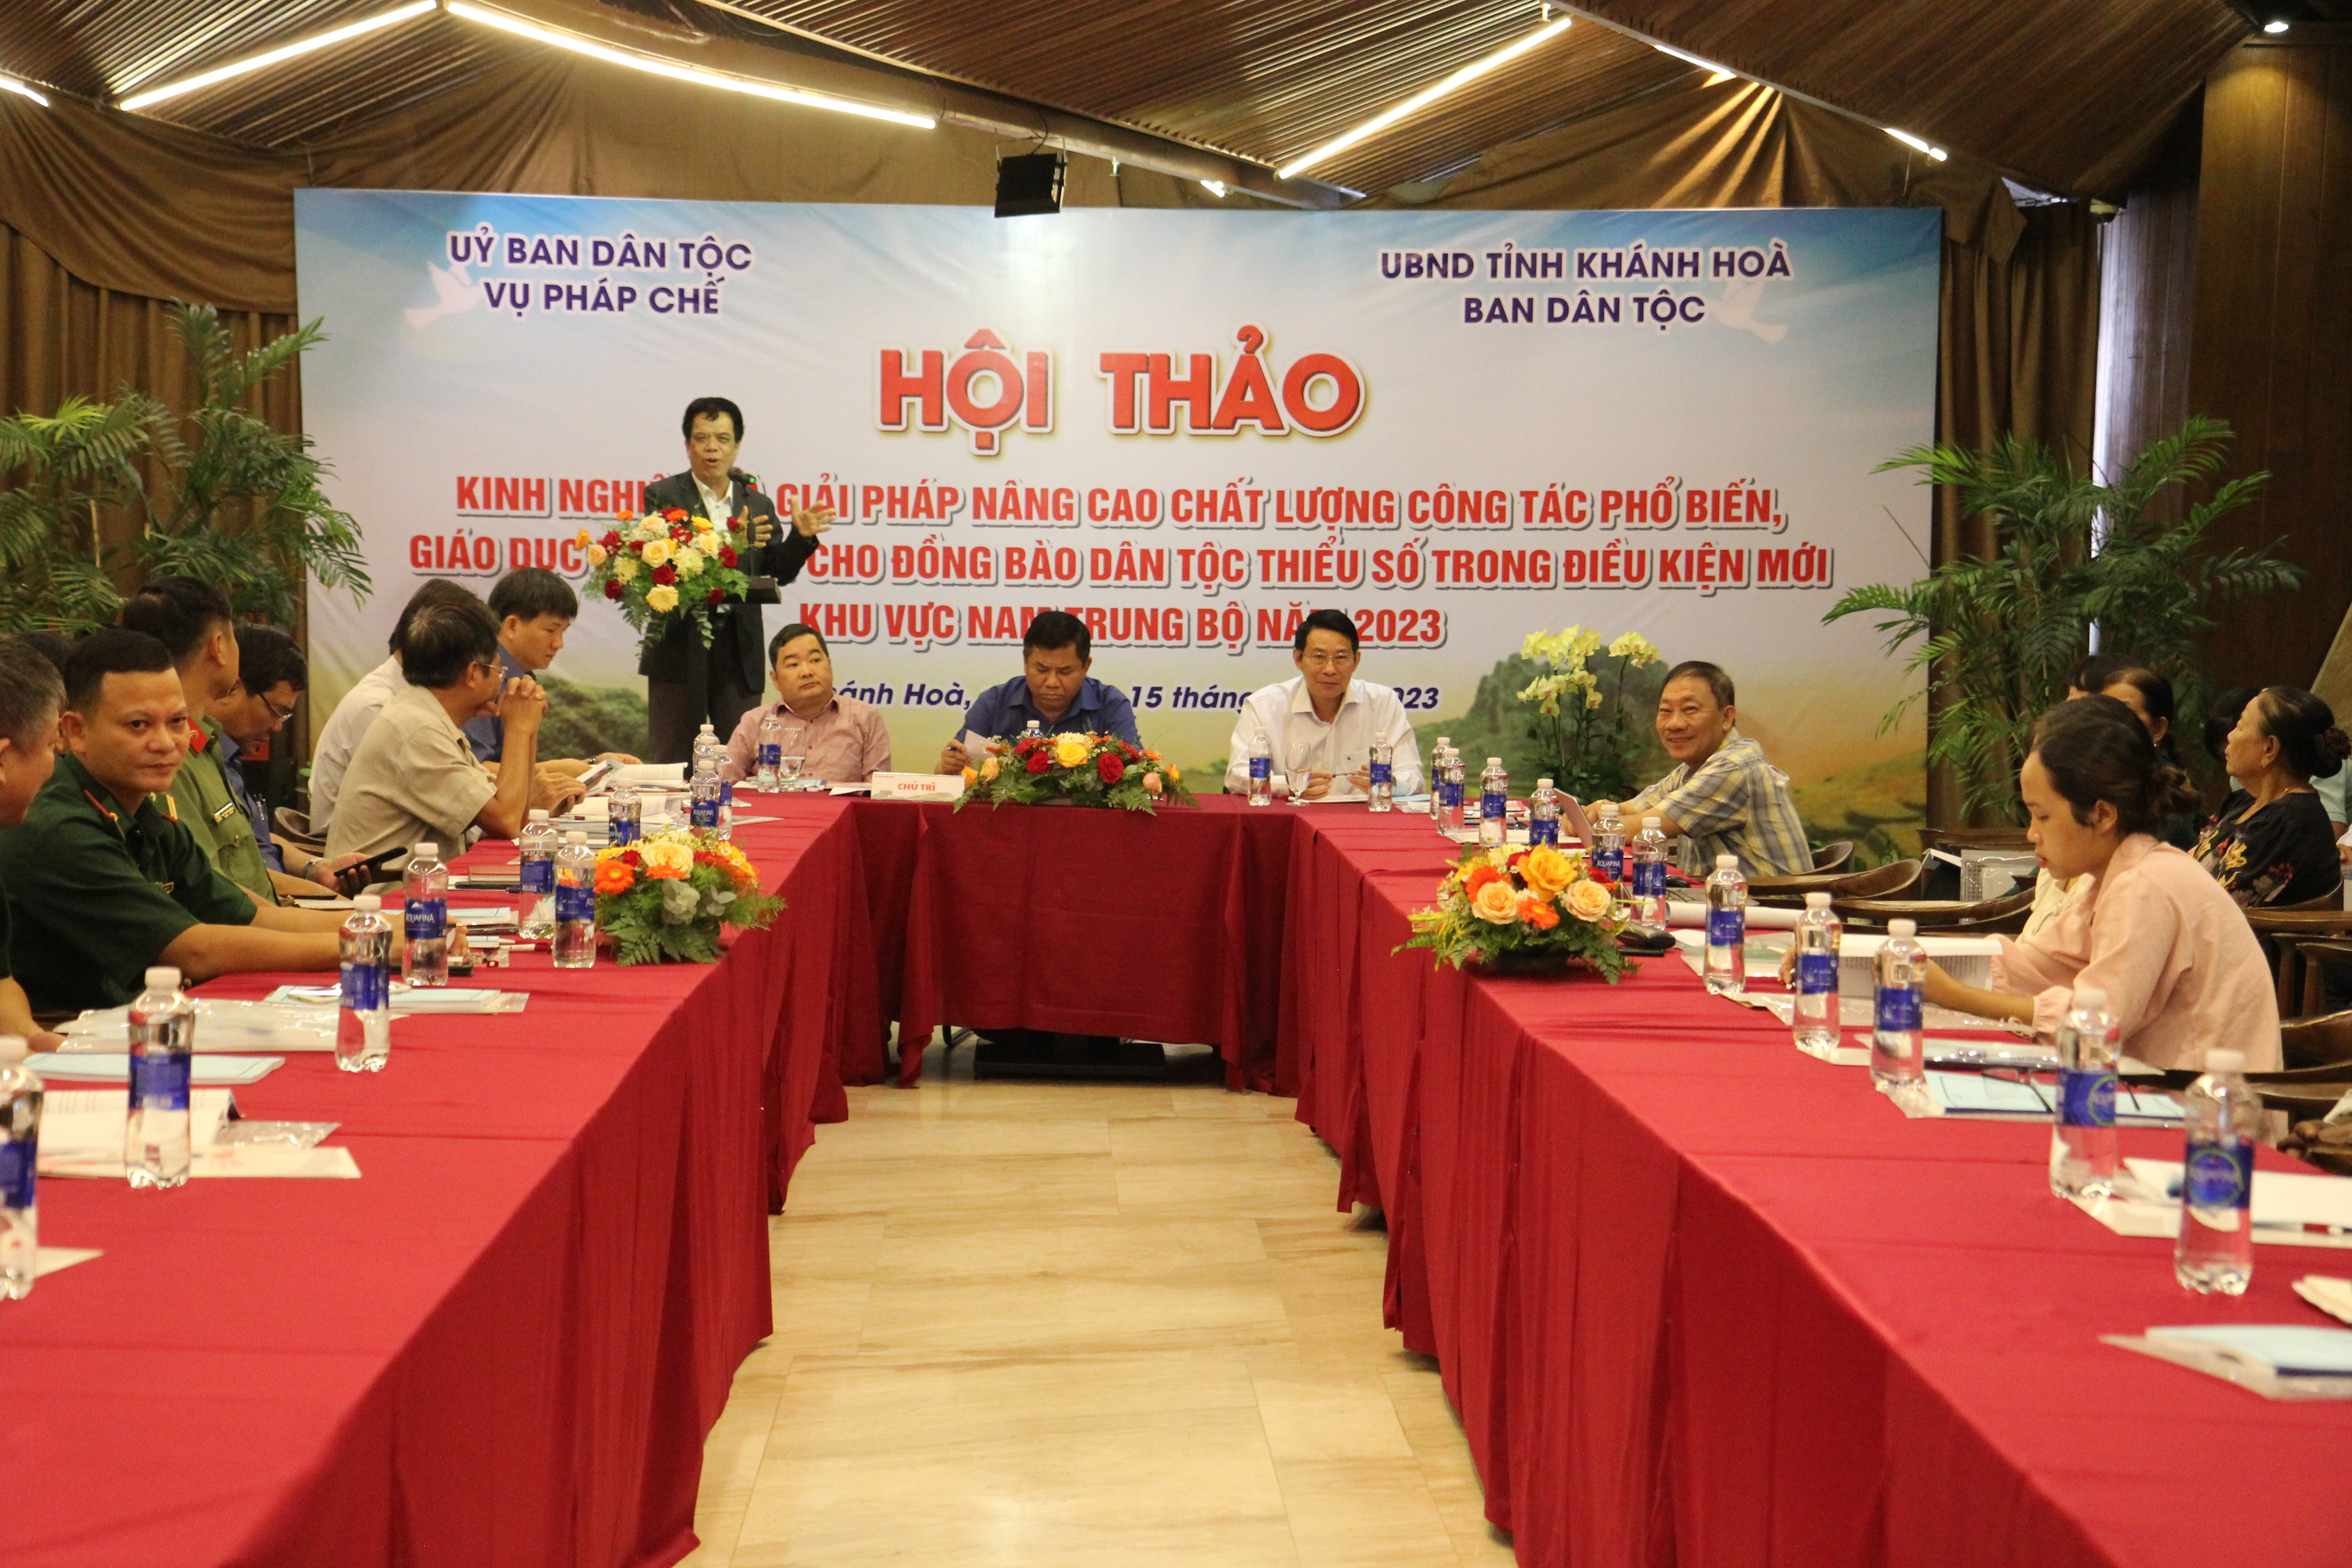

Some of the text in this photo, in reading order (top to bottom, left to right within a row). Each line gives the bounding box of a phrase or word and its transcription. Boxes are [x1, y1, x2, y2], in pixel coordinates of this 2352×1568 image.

[452, 227, 750, 277] UỶ BAN DÂN TỘC
[1382, 241, 1790, 278] UBND TỈNH KHÁNH HOÀ
[485, 277, 725, 316] VỤ PHÁP CHẾ
[1465, 290, 1703, 330] BAN DÂN TỘC
[881, 325, 1361, 449] HỘI THẢO
[458, 473, 1780, 530] KINH NGHI GIẢI PHÁP NÂNG CAO CHẤT LƯỢNG CÔNG TÁC PHỔ BIẾN,
[411, 529, 495, 570] GIÁO
[806, 544, 878, 578] CHO
[892, 534, 990, 579] ĐỒNG
[1006, 541, 1075, 580] BÀO
[1091, 542, 1163, 581] DÂN
[1178, 542, 1243, 589] TỘC
[1258, 536, 1358, 582] THIỂU
[1372, 539, 1420, 583] SỐ
[1432, 550, 1550, 583] TRONG
[1563, 539, 1645, 582] ĐIỀU
[1660, 542, 1743, 589] KIỆN
[1758, 542, 1826, 582] MỚI
[801, 603, 871, 637] KHU
[885, 602, 954, 649] VỰC
[1198, 602, 1246, 649] BỘ
[1258, 602, 1340, 641] NĂ
[1355, 610, 1440, 642] 2023
[833, 681, 893, 704] ánh
[904, 682, 970, 710] Hoà,
[1132, 686, 1162, 708] 15
[1393, 688, 1437, 709] 23
[898, 781, 936, 791] CHỦ TRÌ
[1597, 859, 1621, 868] AQUAFINA
